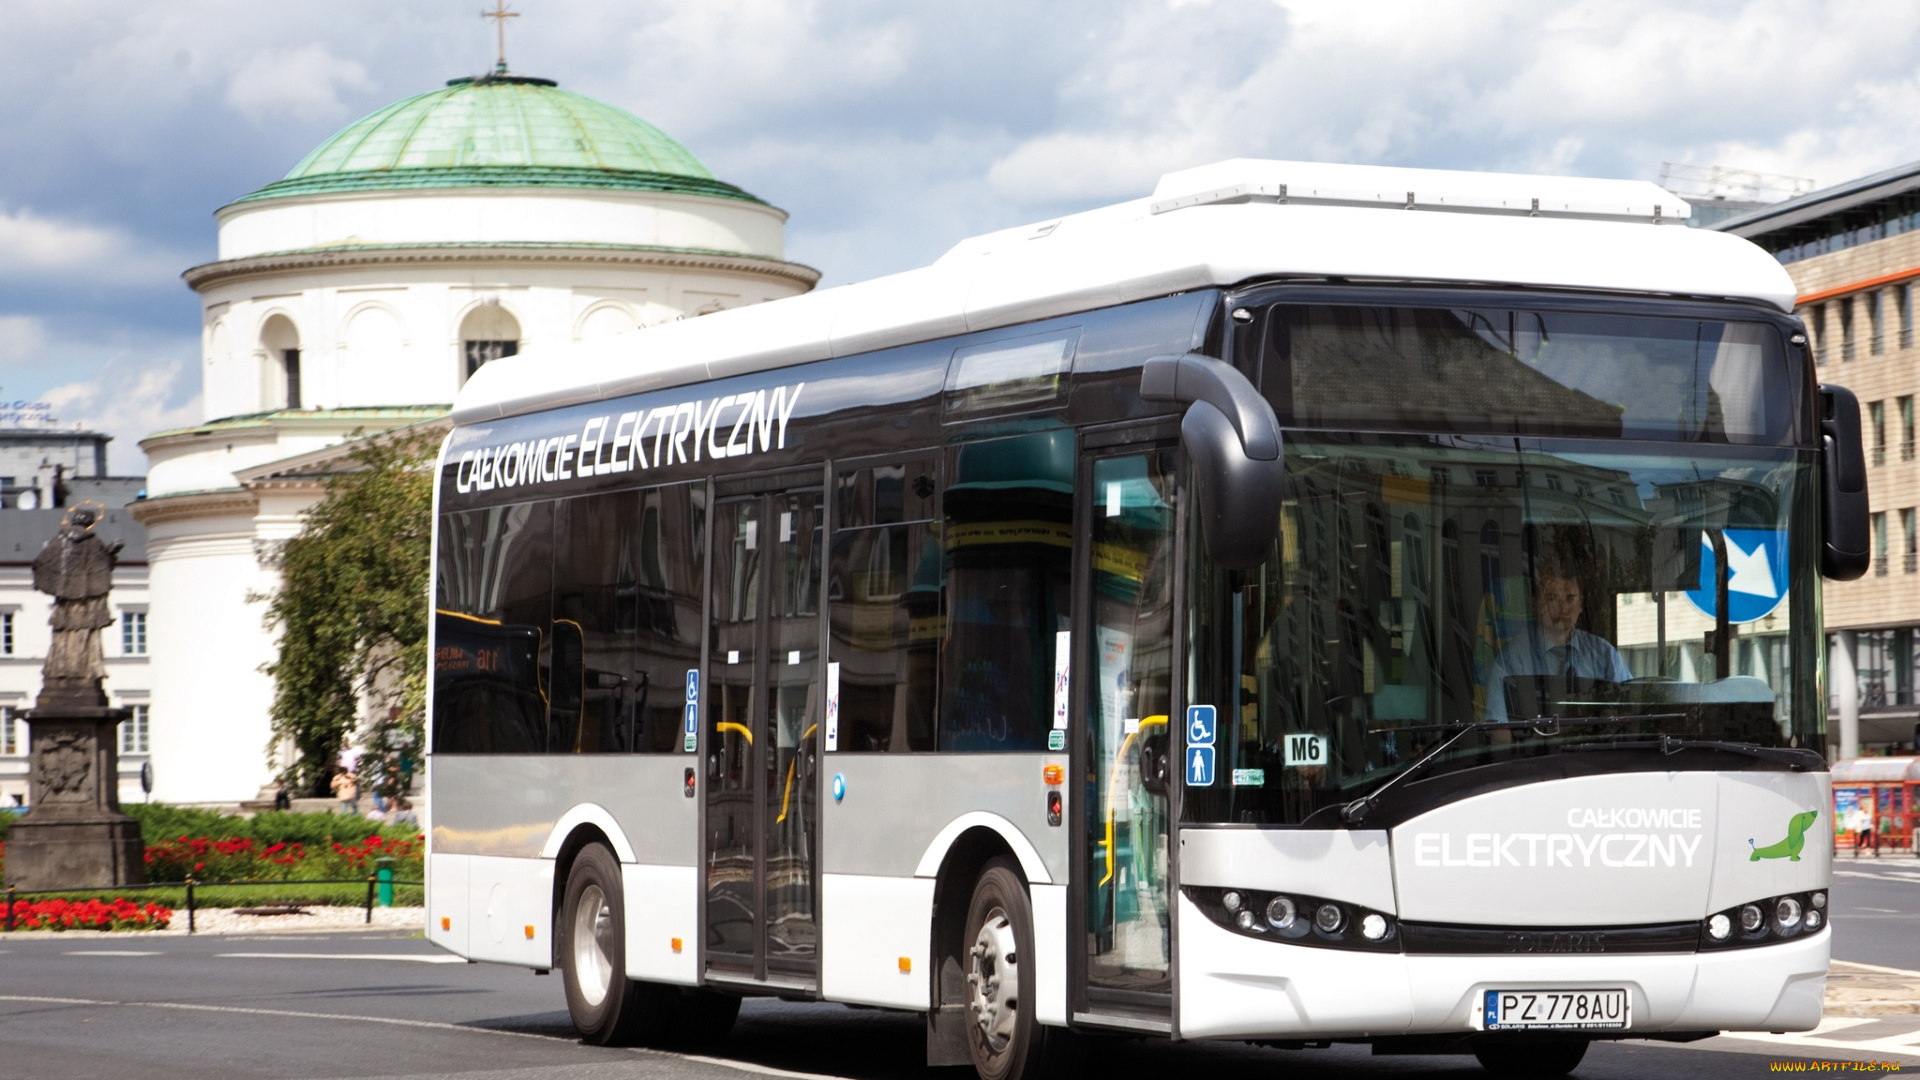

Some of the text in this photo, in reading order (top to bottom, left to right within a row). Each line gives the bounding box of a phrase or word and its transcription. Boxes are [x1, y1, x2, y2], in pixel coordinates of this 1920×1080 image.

[456, 382, 805, 494] CAŁKOWICIE ELEKTRYCZNY
[1291, 737, 1320, 761] M6
[1567, 807, 1702, 829] CAŁKOWICIE
[1415, 832, 1703, 868] ELEKTRYCZNY
[1503, 932, 1606, 954] SOLARIS
[1488, 993, 1620, 1021] PL PZ 778AU
